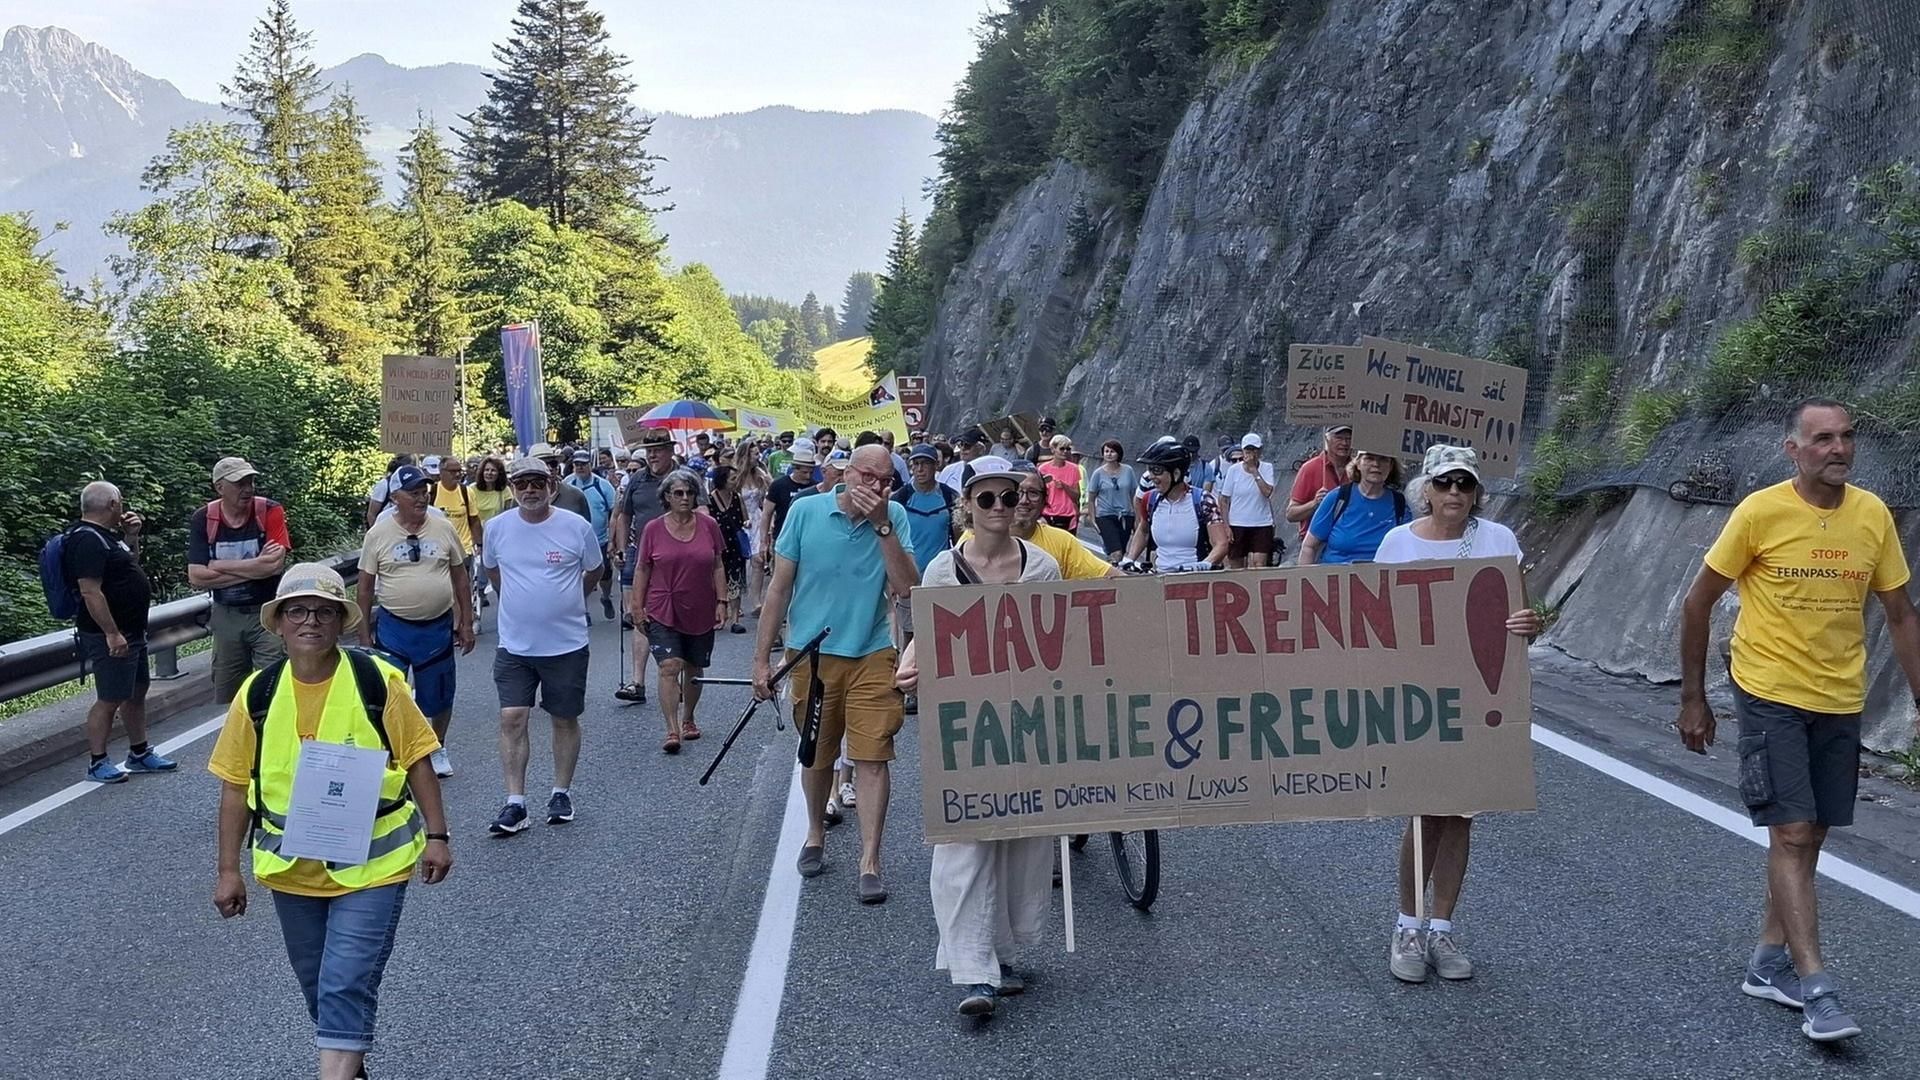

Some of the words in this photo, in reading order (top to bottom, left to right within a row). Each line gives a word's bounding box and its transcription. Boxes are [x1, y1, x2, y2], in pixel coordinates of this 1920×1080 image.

[1296, 349, 1345, 370] ZÜGE
[1366, 348, 1400, 380] Wer
[1405, 355, 1465, 393] TUNNEL
[1481, 378, 1506, 402] sät
[1296, 383, 1346, 401] ZÖLLE
[825, 412, 856, 423] WEDER
[874, 411, 897, 424] NOCH
[1403, 393, 1485, 430] TRANSIT
[1811, 549, 1848, 560] STOPP
[1777, 567, 1869, 581] FERNPASS-PAKET
[932, 588, 1117, 679] MAUT
[938, 678, 1156, 771] FAMILIE
[1217, 687, 1464, 762] FREUNDE
[943, 788, 1043, 824] BESUCHE
[1054, 783, 1117, 811] DÜRFEN
[1126, 780, 1175, 802] KEIN
[1186, 774, 1250, 801] LUXUS
